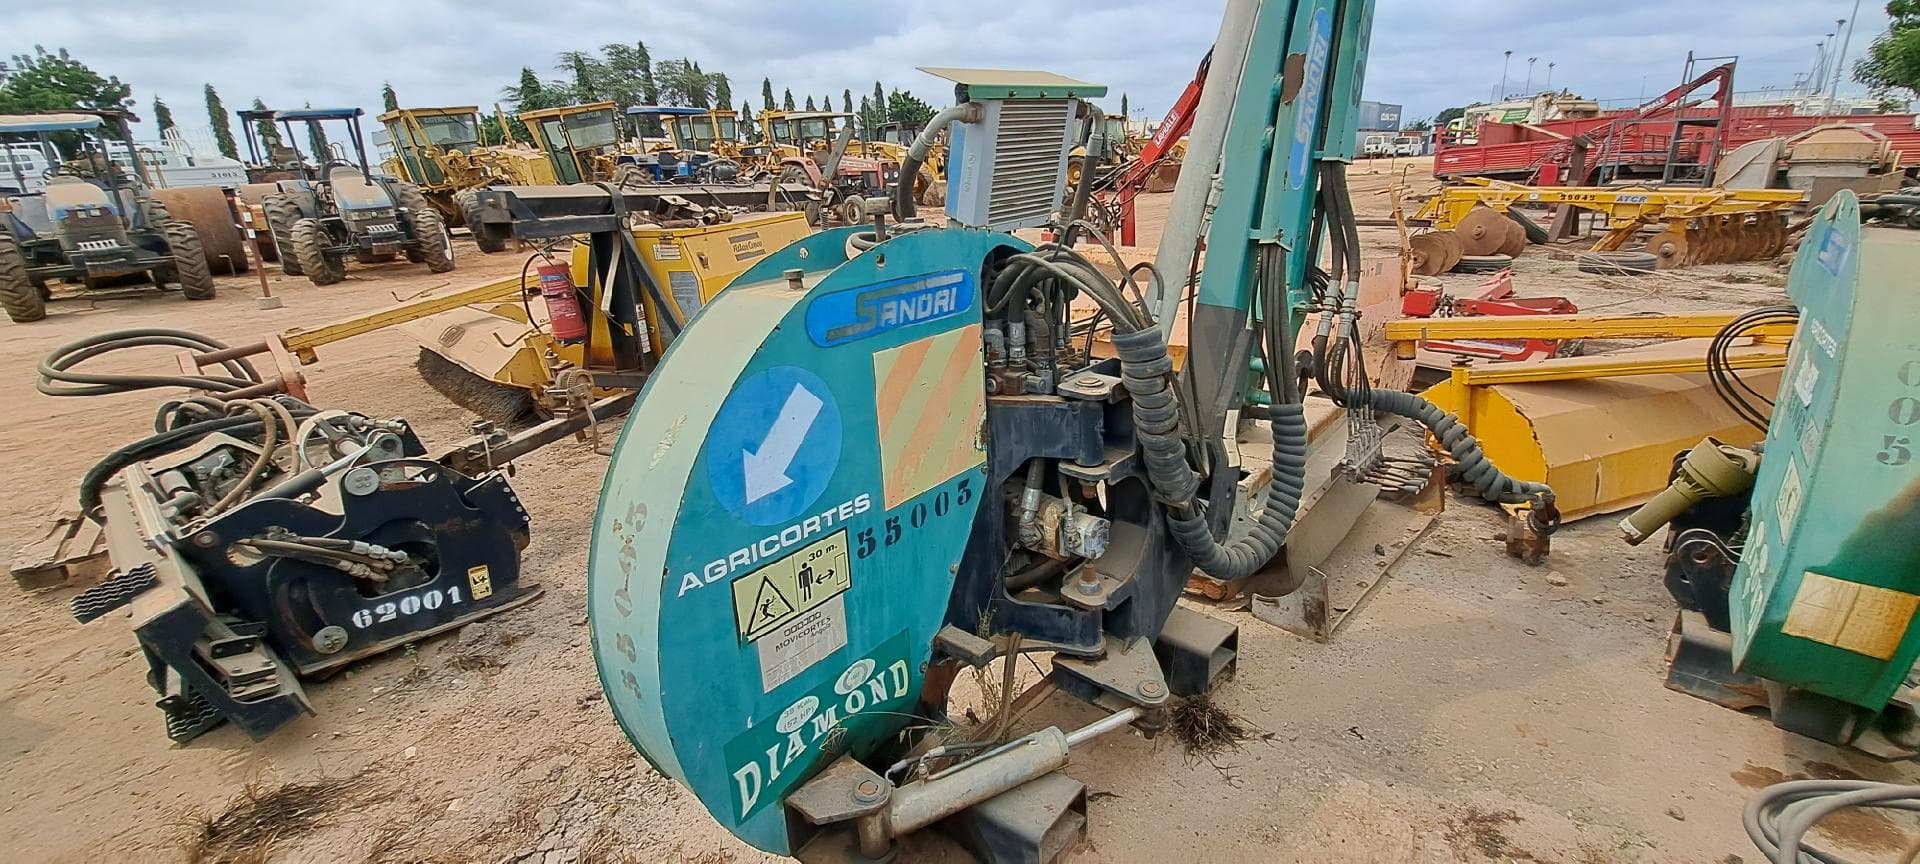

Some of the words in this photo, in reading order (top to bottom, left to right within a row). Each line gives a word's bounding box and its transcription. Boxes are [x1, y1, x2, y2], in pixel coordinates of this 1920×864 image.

[826, 273, 964, 342] SANDRI
[678, 493, 871, 598] AGRICORTES
[857, 478, 972, 560] 55003
[808, 549, 823, 562] 30
[352, 585, 463, 629] 62001
[775, 617, 832, 653] MOVICORTES
[733, 659, 909, 819] DIAMOND
